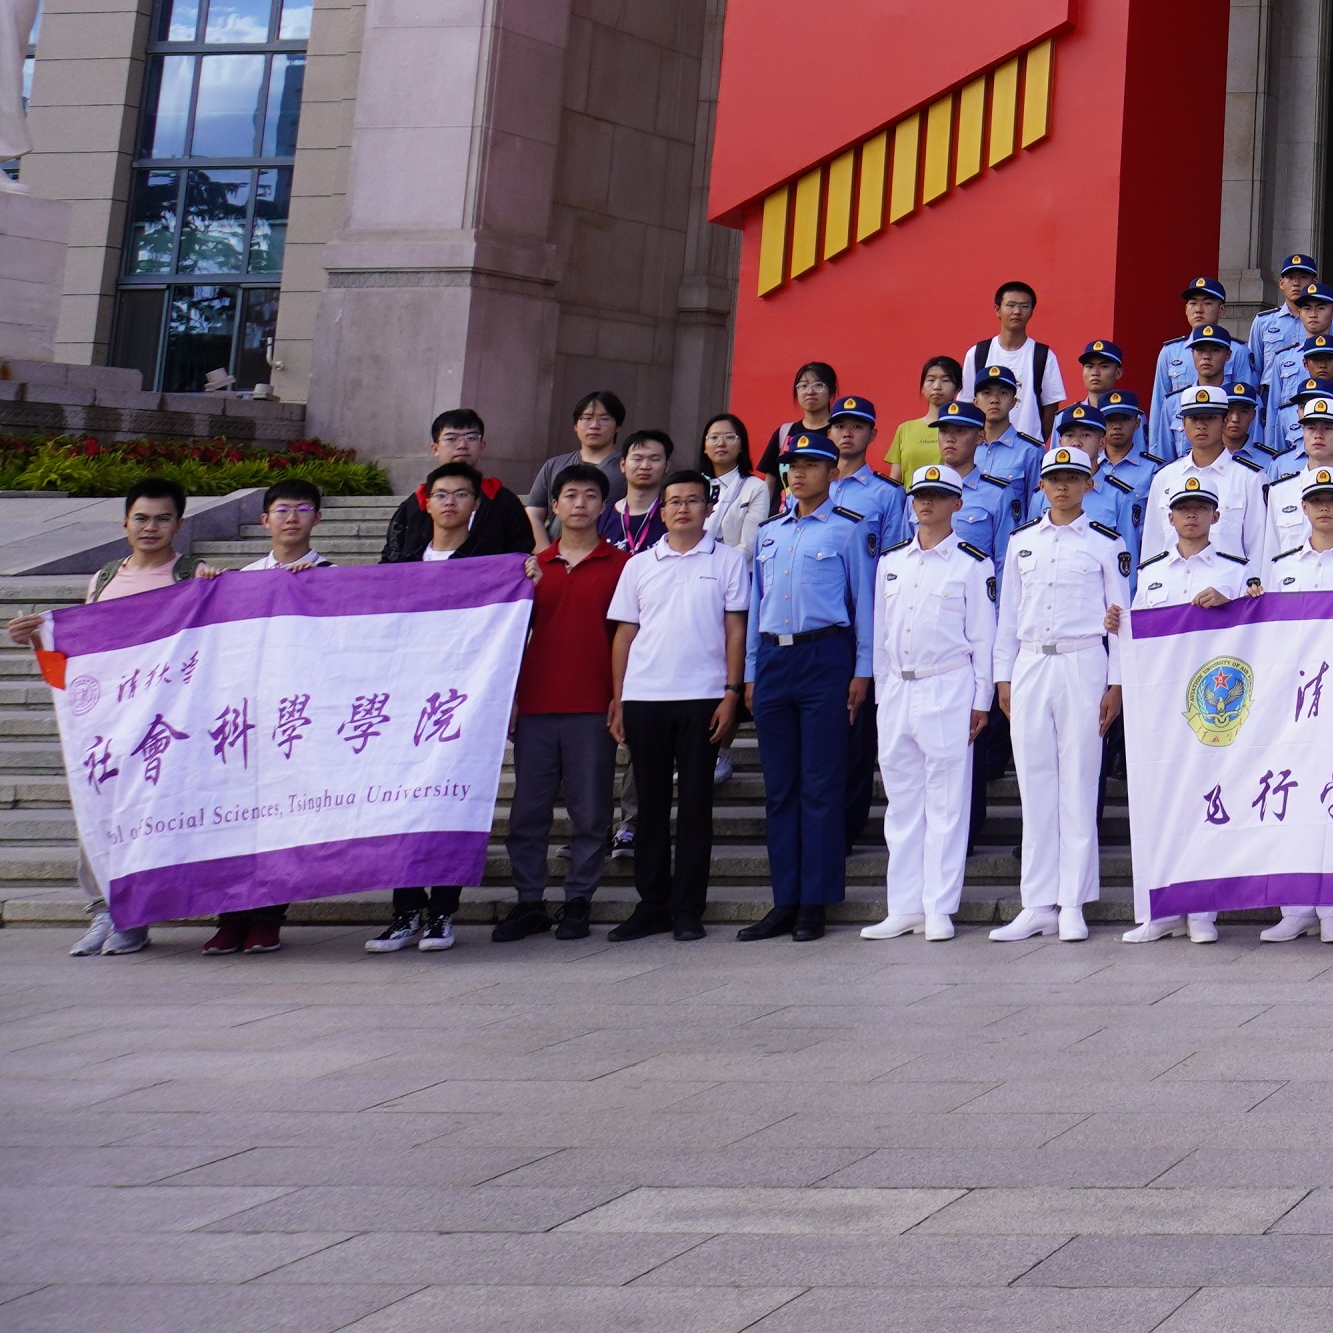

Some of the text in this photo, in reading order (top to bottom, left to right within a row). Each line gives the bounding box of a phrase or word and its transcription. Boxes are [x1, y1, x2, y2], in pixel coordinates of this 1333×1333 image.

[82, 688, 469, 797] 社會科學學院
[145, 807, 205, 836] Social
[289, 789, 356, 814] Tsinghua
[367, 778, 472, 803] University
